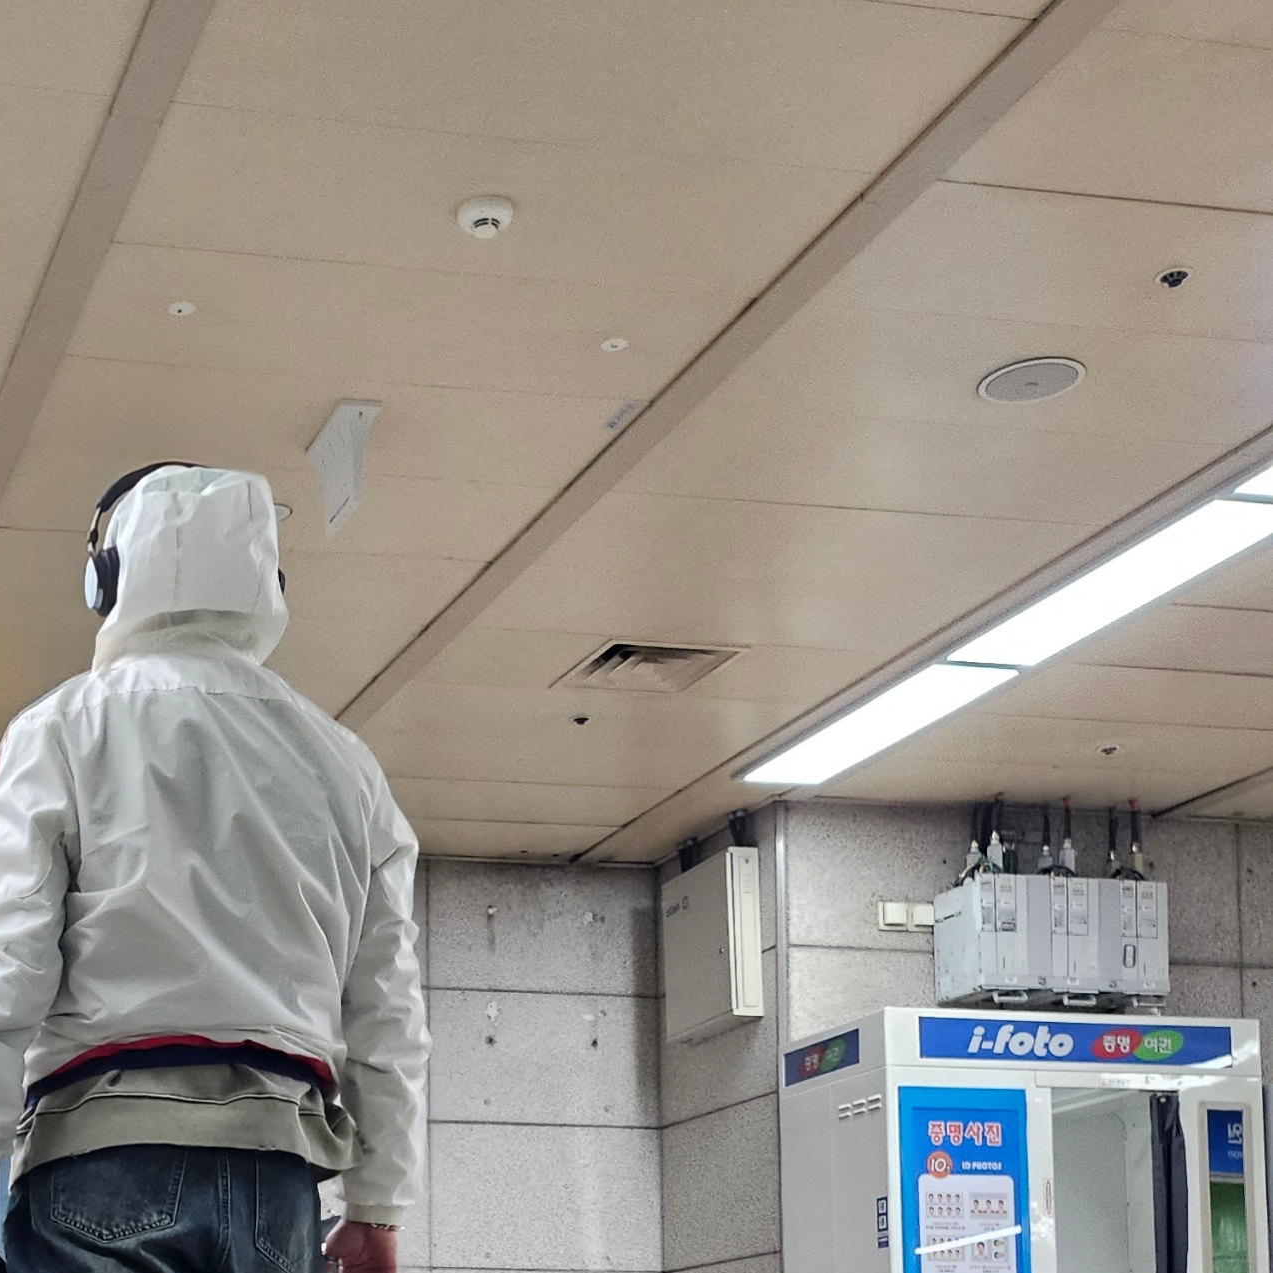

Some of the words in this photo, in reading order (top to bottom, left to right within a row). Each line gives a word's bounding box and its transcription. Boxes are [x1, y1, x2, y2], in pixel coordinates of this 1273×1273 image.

[967, 1024, 1074, 1057] i-foto
[1103, 1035, 1130, 1053] 증명
[1145, 1037, 1172, 1055] 여권
[928, 1120, 1002, 1147] 증명사진
